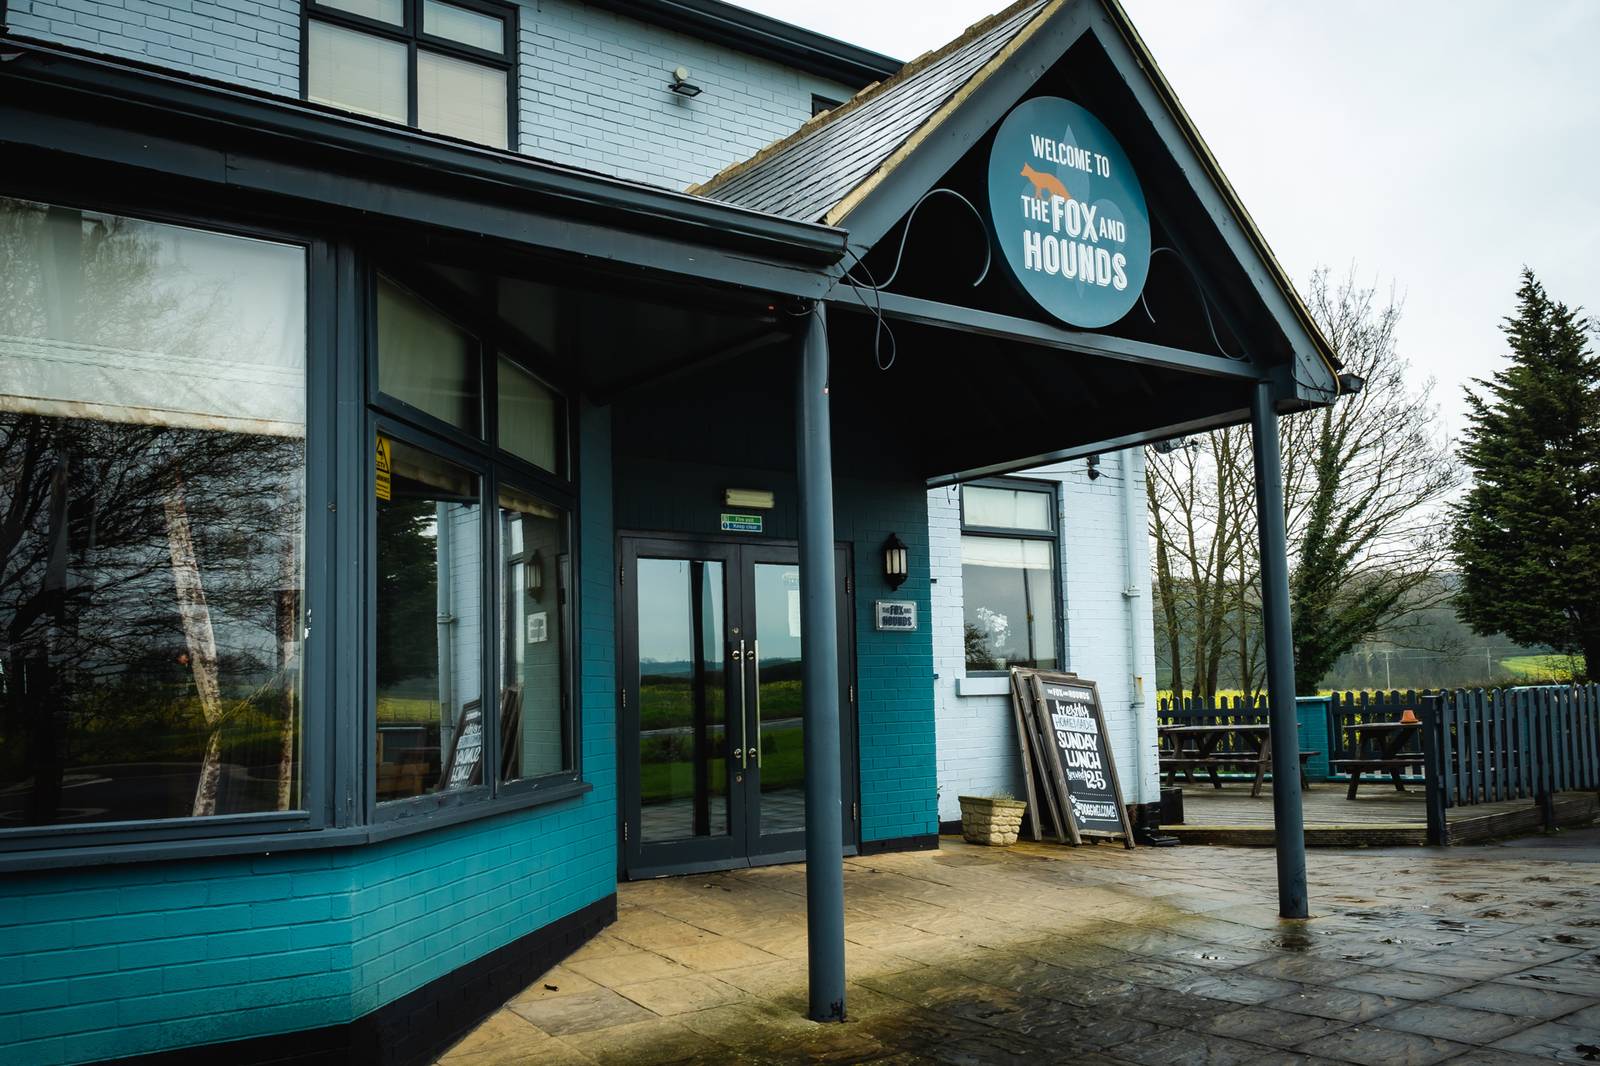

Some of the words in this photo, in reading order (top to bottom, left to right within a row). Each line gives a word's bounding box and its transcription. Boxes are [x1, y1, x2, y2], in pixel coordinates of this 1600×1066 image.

[1030, 134, 1093, 173] WELCOME
[1095, 153, 1110, 178] TO
[1021, 195, 1050, 223] THE
[1051, 194, 1099, 243] FOX
[1099, 216, 1126, 243] AND
[1023, 229, 1128, 291] HOUNDS
[890, 604, 904, 615] FOX
[882, 616, 912, 626] HOUNDS
[1053, 688, 1063, 697] FOX
[1068, 690, 1090, 700] HOUNDS
[1055, 716, 1095, 731] HOMEMADE
[1057, 731, 1098, 751] SUNDAY
[1065, 749, 1102, 769] LUNCH
